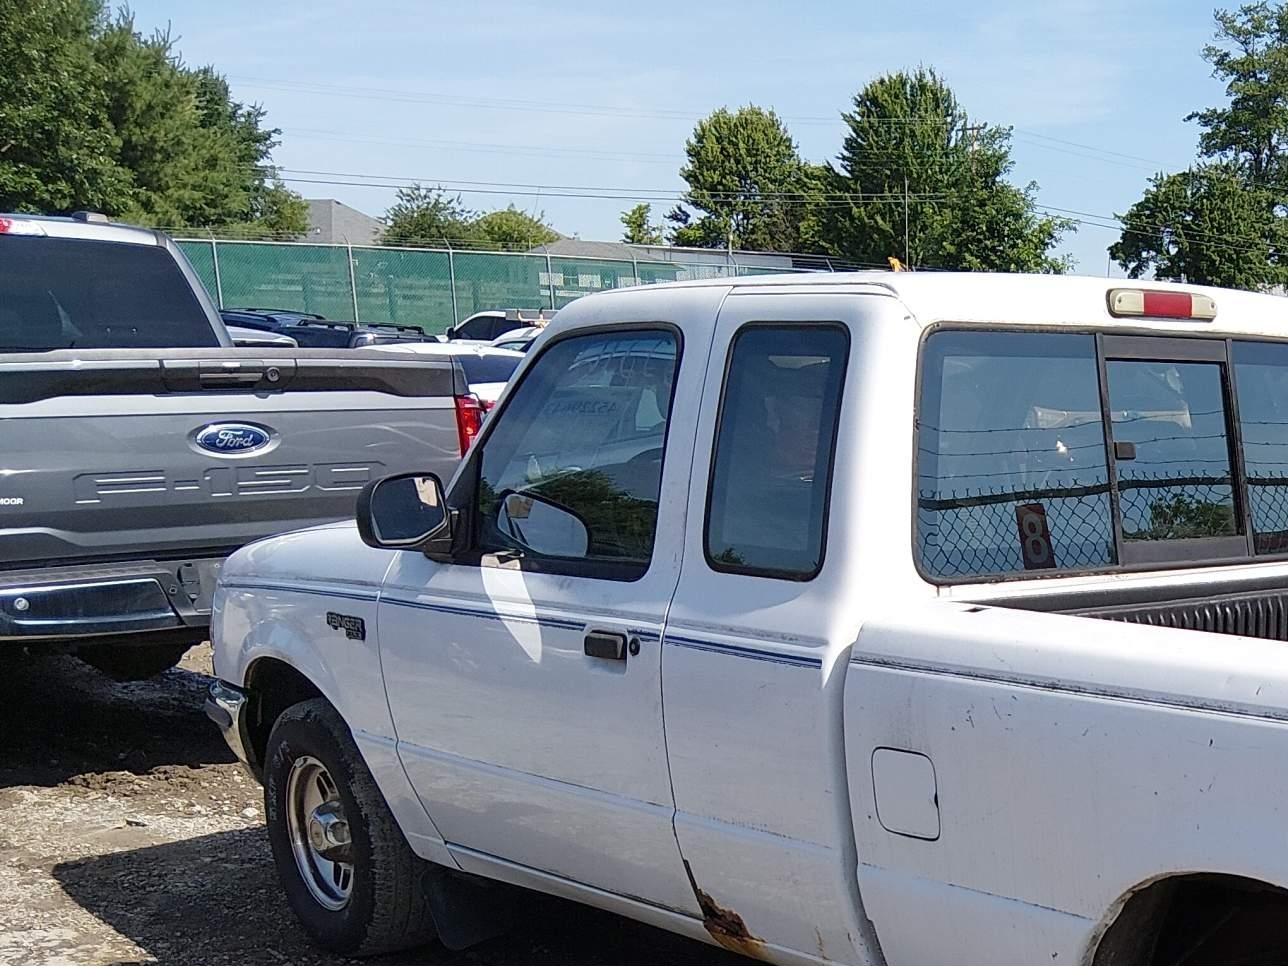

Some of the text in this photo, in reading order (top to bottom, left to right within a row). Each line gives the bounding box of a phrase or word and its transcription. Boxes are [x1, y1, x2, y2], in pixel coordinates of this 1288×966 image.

[216, 430, 254, 447] Ford
[73, 460, 386, 503] F-150
[1023, 512, 1049, 563] 8
